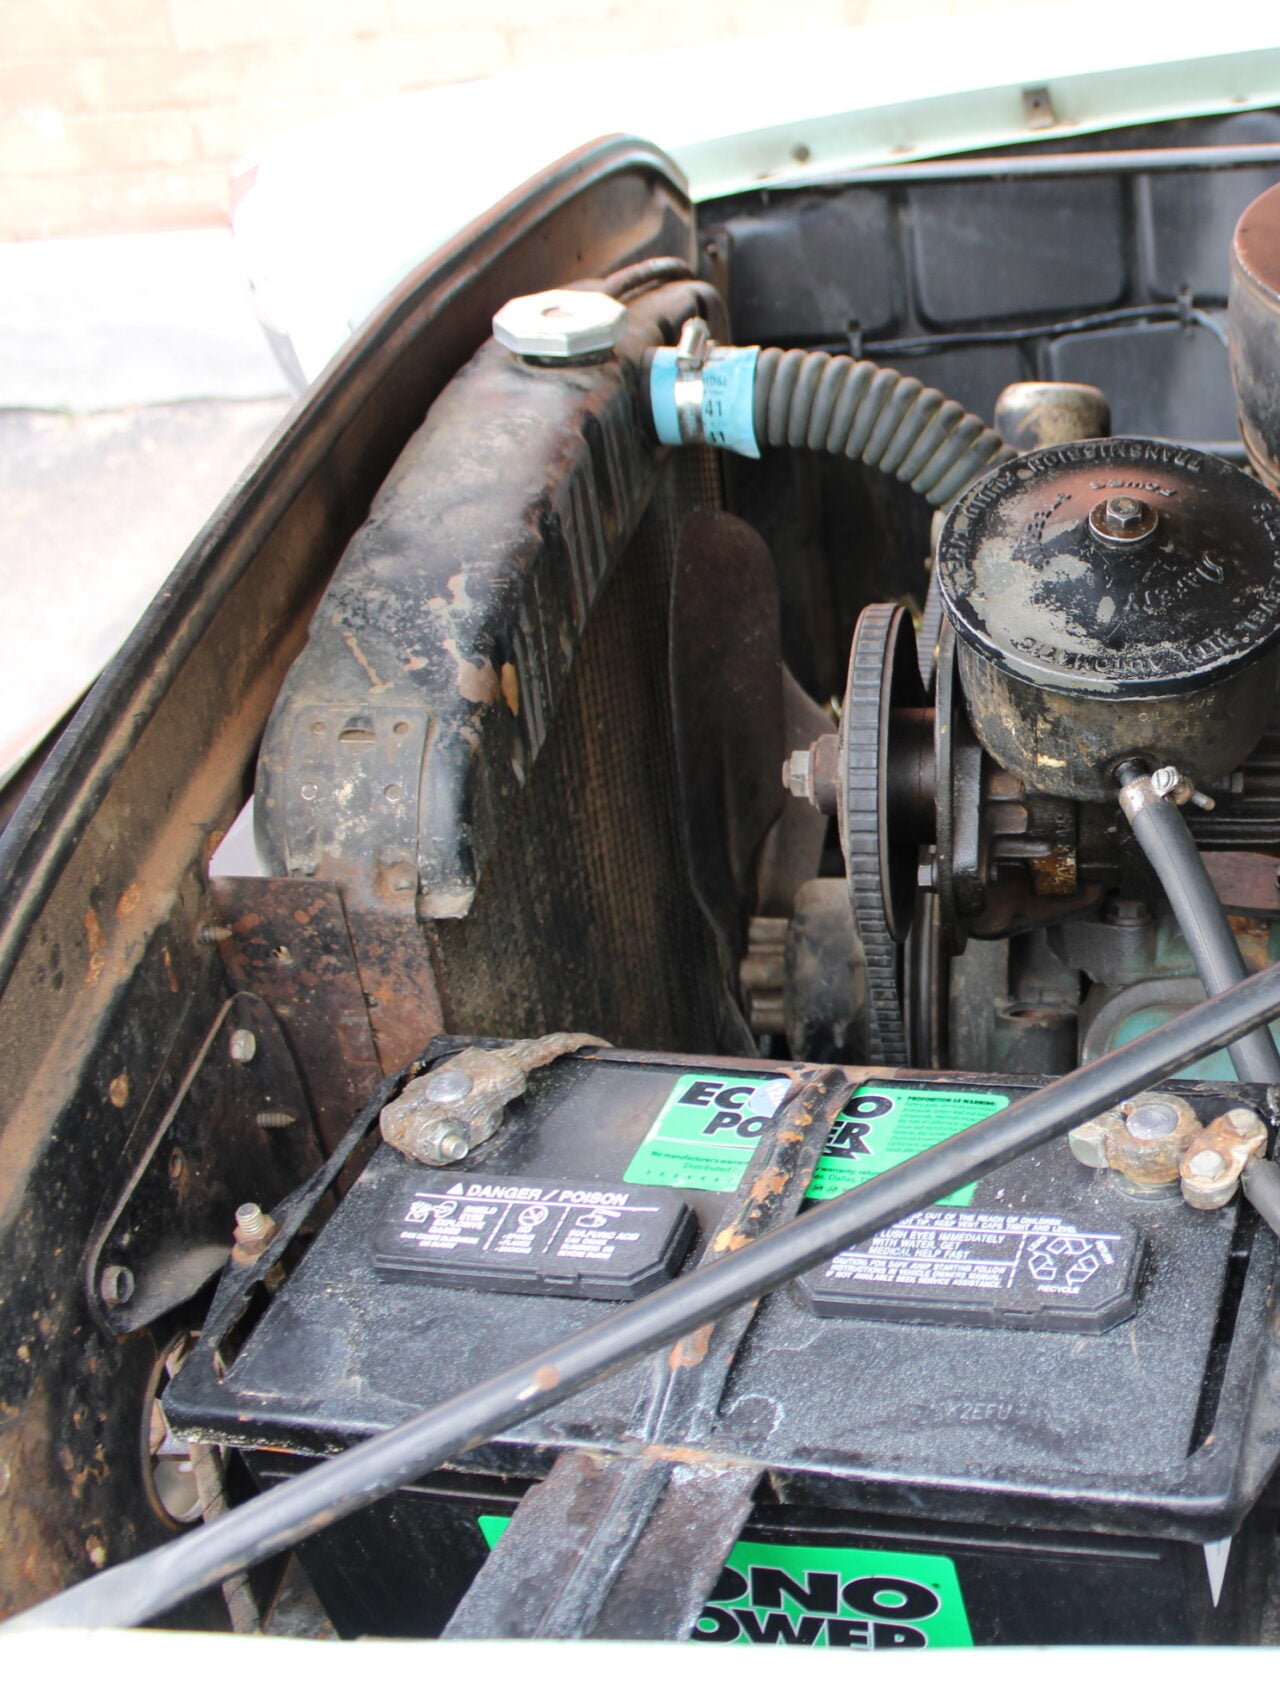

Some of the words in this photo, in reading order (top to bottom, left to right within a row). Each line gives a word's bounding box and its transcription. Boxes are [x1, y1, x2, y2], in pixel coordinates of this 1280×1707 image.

[1027, 442, 1203, 475] TRANSMISSION
[1013, 635, 1165, 674] AUTOMATIC
[466, 1184, 539, 1201] DANGER
[559, 1190, 629, 1206] POISON
[934, 1220, 955, 1228] KEEP
[958, 1221, 979, 1229] VENT
[981, 1222, 1003, 1230] CAPS
[1006, 1223, 1030, 1231] TIGHT
[958, 1214, 977, 1222] THE
[978, 1215, 1005, 1223] REACH
[1020, 1217, 1062, 1226] CHILDREN
[568, 1229, 617, 1240] SULFURIC
[615, 1232, 640, 1241] ACID
[909, 1231, 936, 1241] EYES
[938, 1233, 1006, 1244] IMMEDIATELY
[872, 1238, 897, 1248] WITH
[939, 1241, 962, 1250] GET
[868, 1246, 911, 1258] MEDICAL
[914, 1248, 942, 1258] HELP
[943, 1250, 970, 1260] FAST
[869, 1258, 886, 1267] FOR
[887, 1259, 909, 1268] SAFE
[933, 1262, 972, 1272] STARTING
[973, 1265, 1008, 1275] FOLLOW
[834, 1271, 853, 1279] NOT
[1037, 1285, 1081, 1295] RECYCLE
[691, 1606, 928, 1650] OWER
